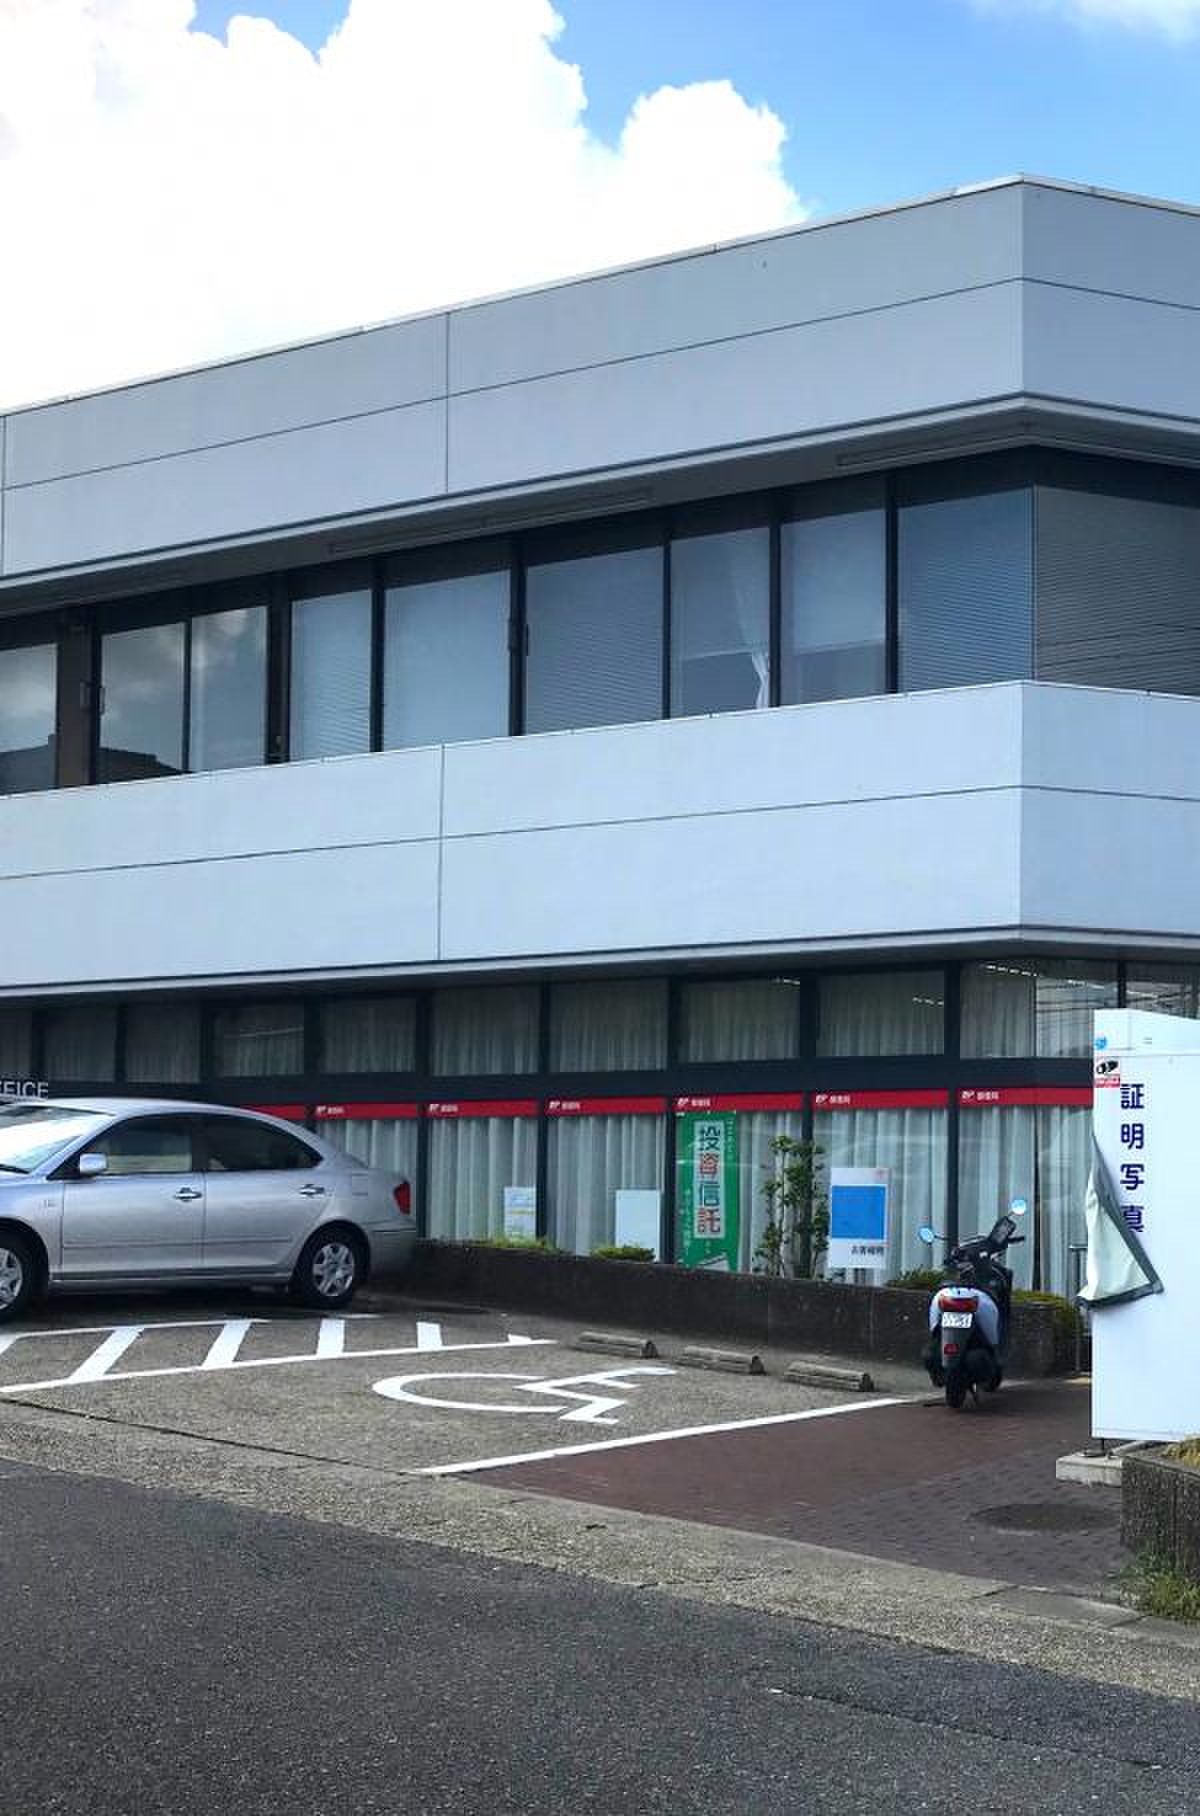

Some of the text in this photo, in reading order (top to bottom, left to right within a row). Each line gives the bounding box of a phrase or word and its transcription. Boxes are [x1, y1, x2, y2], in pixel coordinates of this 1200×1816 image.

[0, 1081, 48, 1098] FICE
[698, 1125, 721, 1233] 投資信託
[1120, 1083, 1144, 1232] 証明写真
